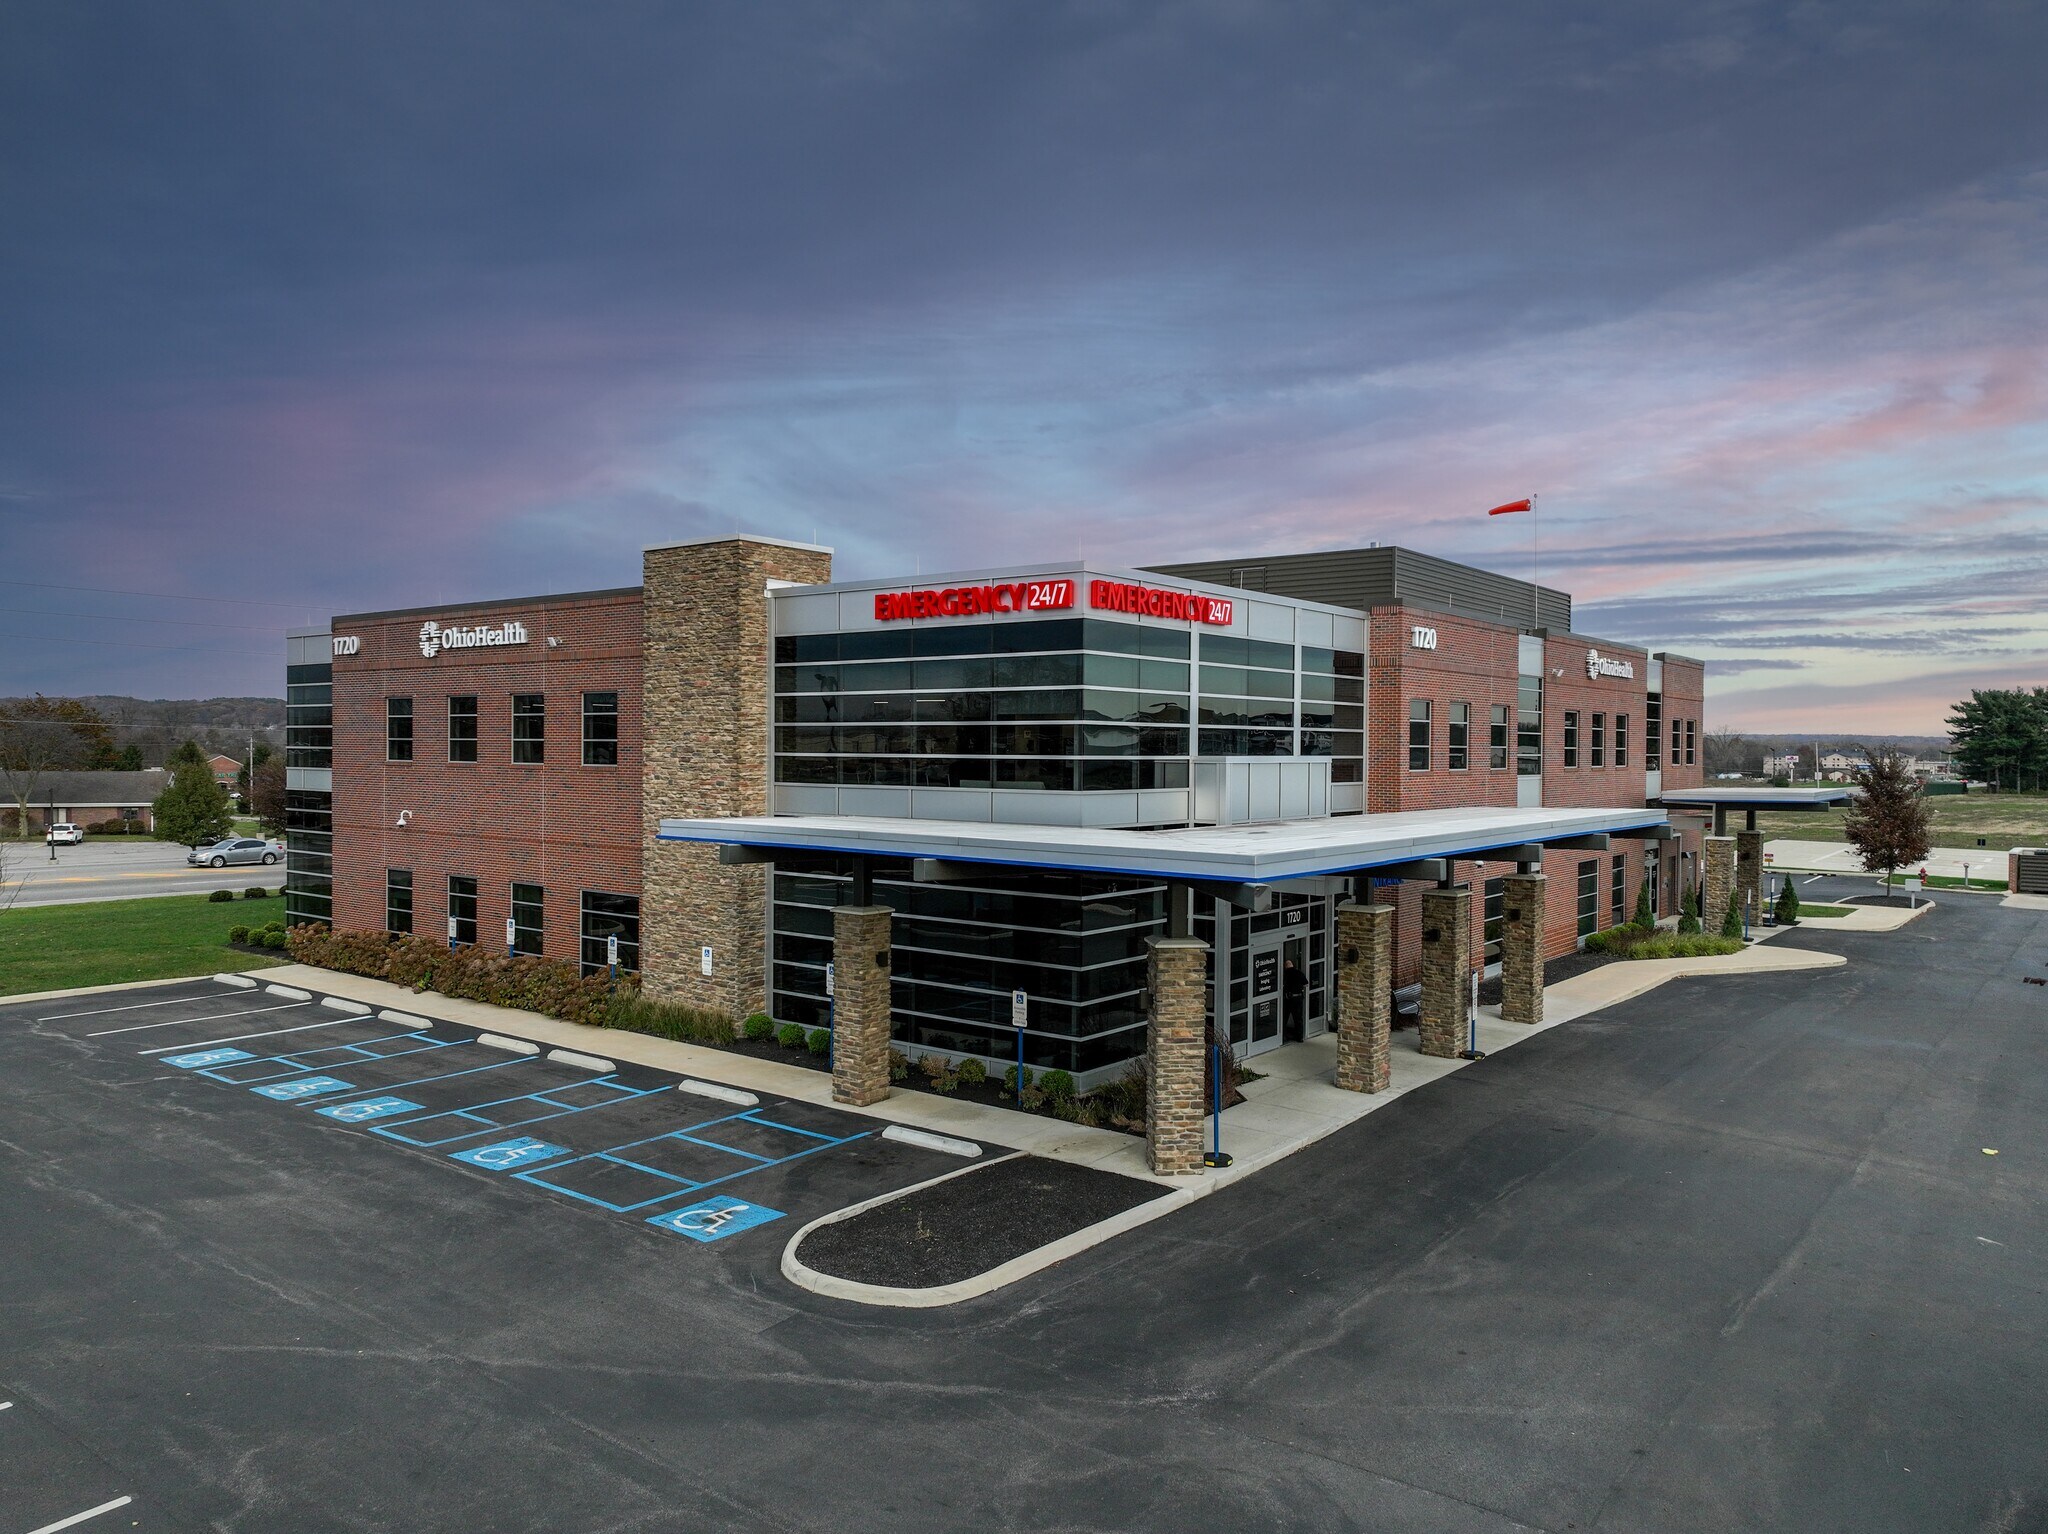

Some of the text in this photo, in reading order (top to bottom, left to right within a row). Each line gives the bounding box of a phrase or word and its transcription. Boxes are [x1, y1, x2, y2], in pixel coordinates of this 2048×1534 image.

[875, 582, 1067, 621] EMERGENCY 24/7
[1091, 580, 1231, 622] EMERGENCY 24/7
[333, 635, 360, 655] 1720
[441, 621, 529, 650] OhioHealth
[1411, 625, 1437, 650] 1720
[1599, 657, 1634, 679] OhioHealth
[1286, 910, 1301, 924] 1720
